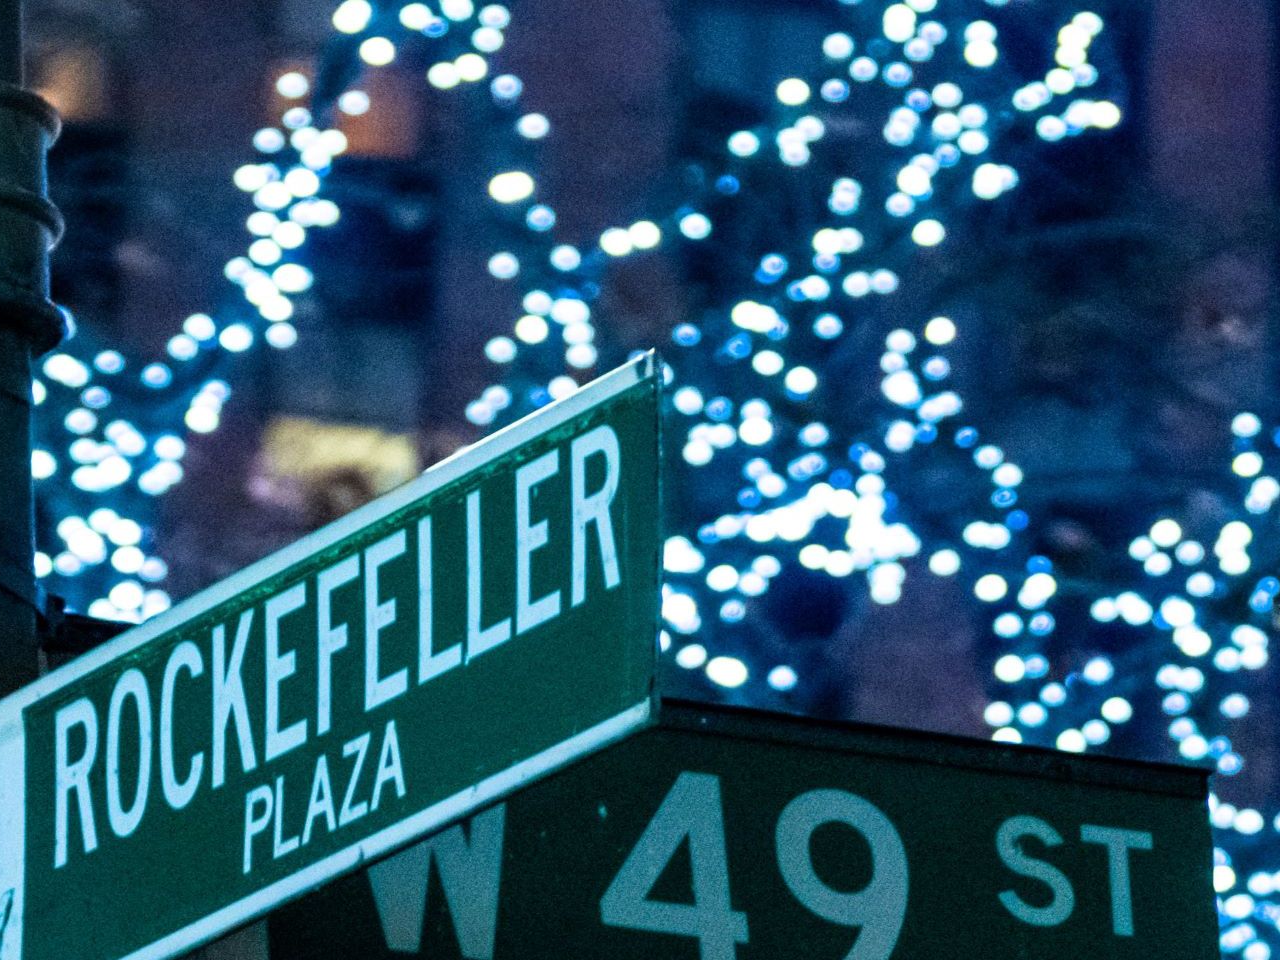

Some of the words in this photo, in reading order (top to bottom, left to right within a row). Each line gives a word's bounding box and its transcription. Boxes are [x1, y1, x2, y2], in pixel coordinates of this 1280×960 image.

[53, 425, 621, 868] ROCKEFELLER
[243, 719, 406, 875] PLAZA
[995, 815, 1154, 936] ST
